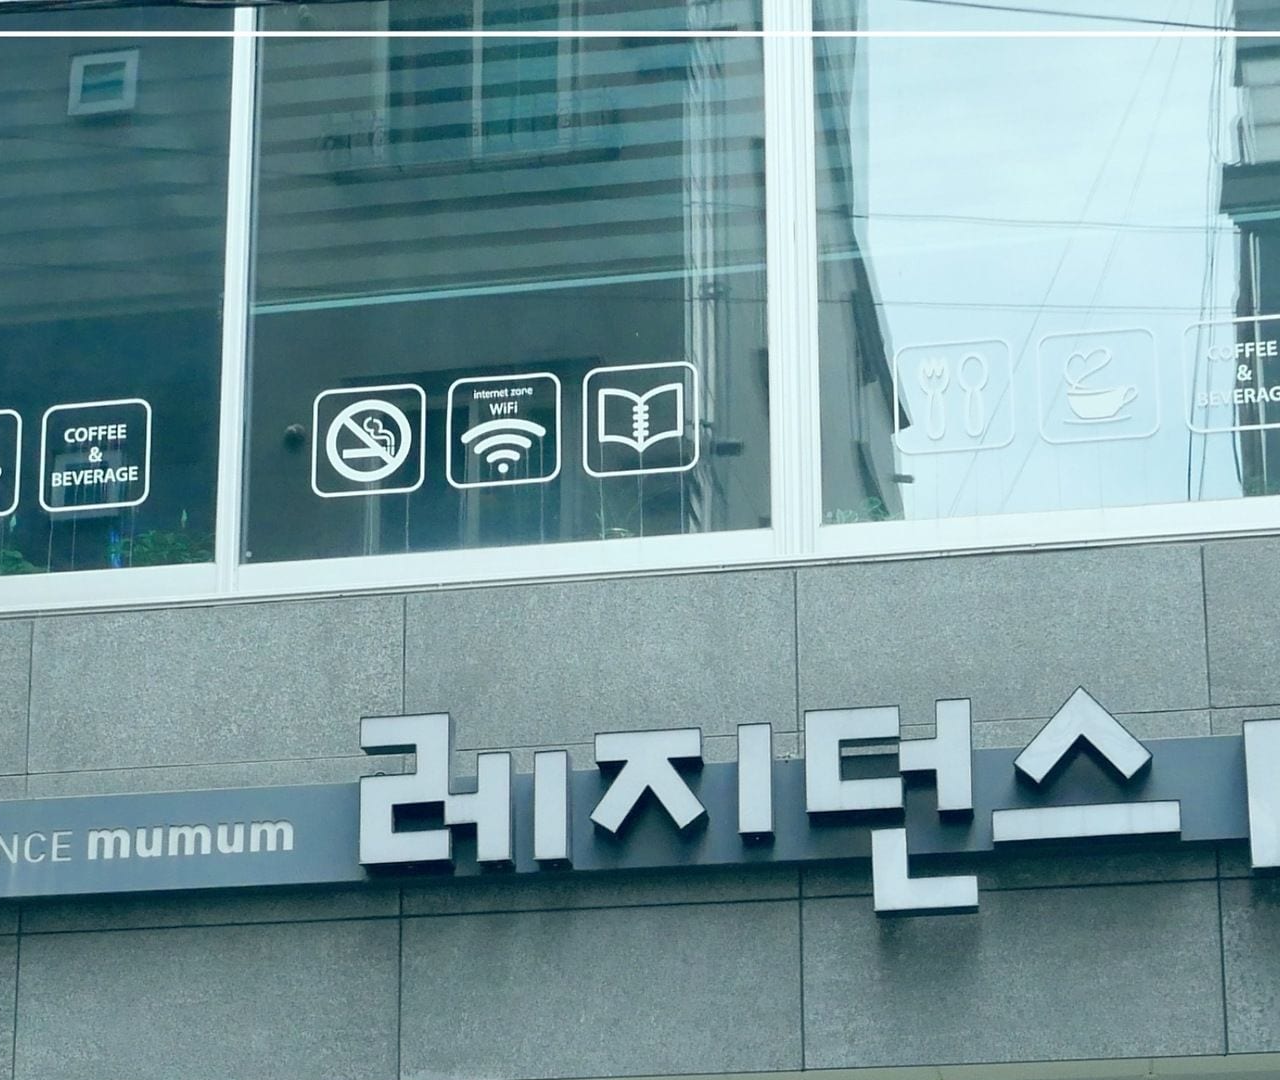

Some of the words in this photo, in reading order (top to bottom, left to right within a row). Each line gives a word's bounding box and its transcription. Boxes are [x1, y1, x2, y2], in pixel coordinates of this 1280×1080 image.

[1207, 340, 1279, 361] COFFEE
[1237, 364, 1253, 381] &
[473, 387, 509, 400] internet
[510, 386, 534, 397] zone
[489, 401, 519, 416] WiFi
[63, 424, 127, 444] COFFEE
[88, 446, 103, 463] &
[51, 465, 139, 488] BEVERAGE
[359, 685, 1182, 914] 레지던스
[87, 819, 295, 861] mumum
